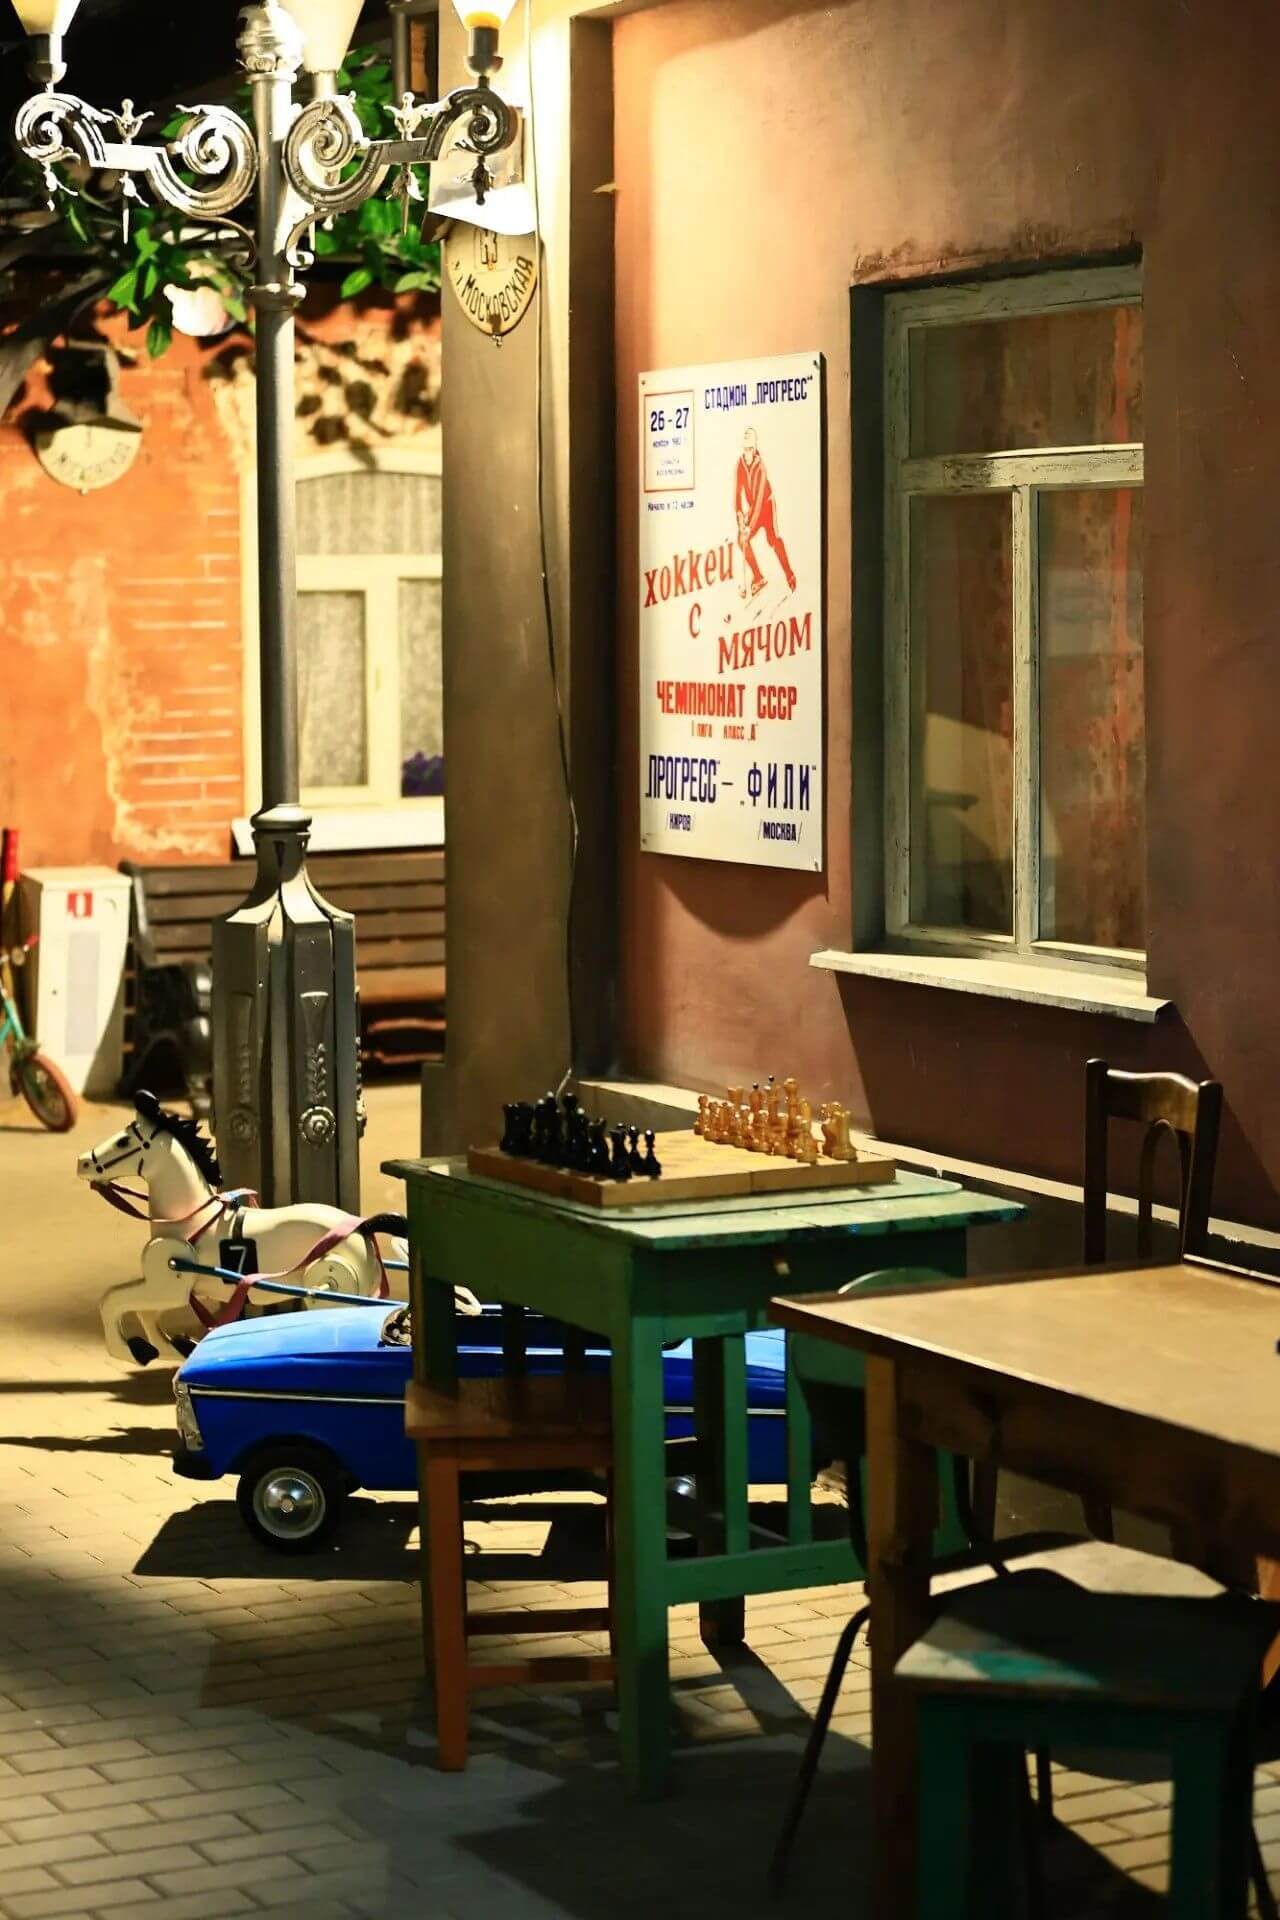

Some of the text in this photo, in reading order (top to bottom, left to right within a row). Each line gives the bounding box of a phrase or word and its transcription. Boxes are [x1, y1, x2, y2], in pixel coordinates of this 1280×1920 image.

[704, 384, 748, 411] СТАДИОН
[656, 681, 797, 720] ЧЕМПИОНАТ СССР
